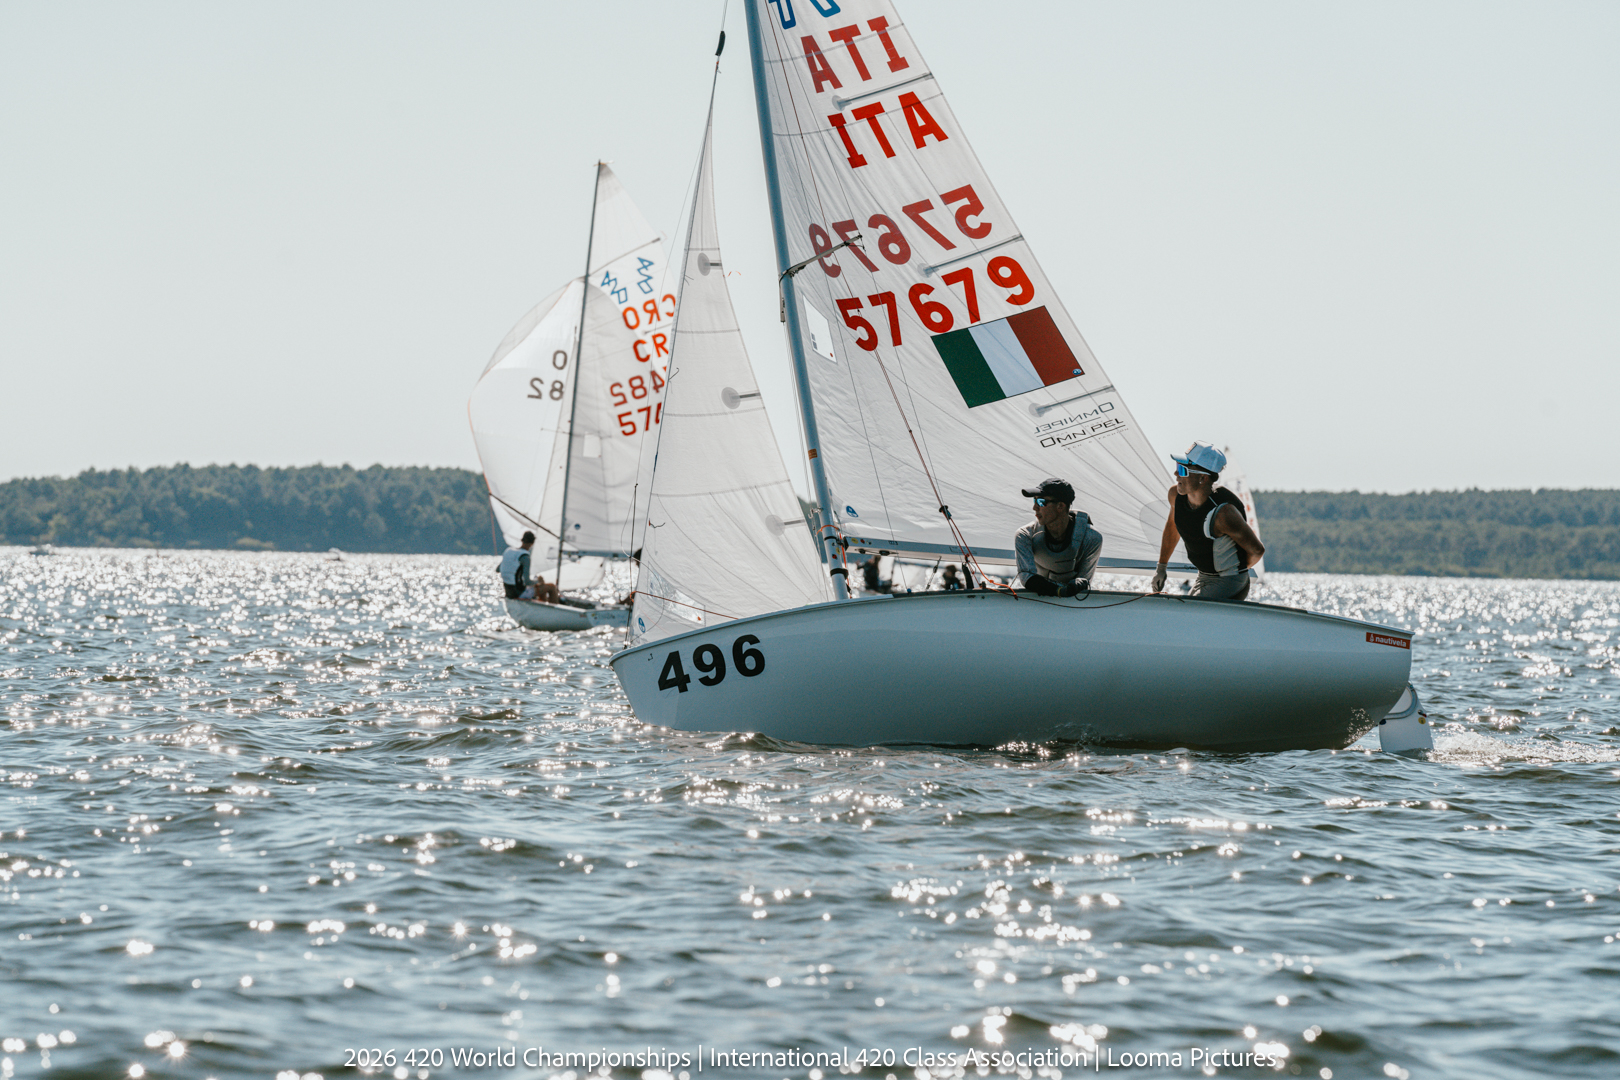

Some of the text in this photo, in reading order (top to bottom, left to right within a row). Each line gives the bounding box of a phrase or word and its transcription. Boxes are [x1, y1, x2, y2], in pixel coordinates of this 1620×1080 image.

[827, 91, 949, 169] ITA
[835, 255, 1035, 352] 57679
[633, 333, 669, 362] CR
[658, 634, 765, 693] 496
[1375, 636, 1407, 648] nautivela
